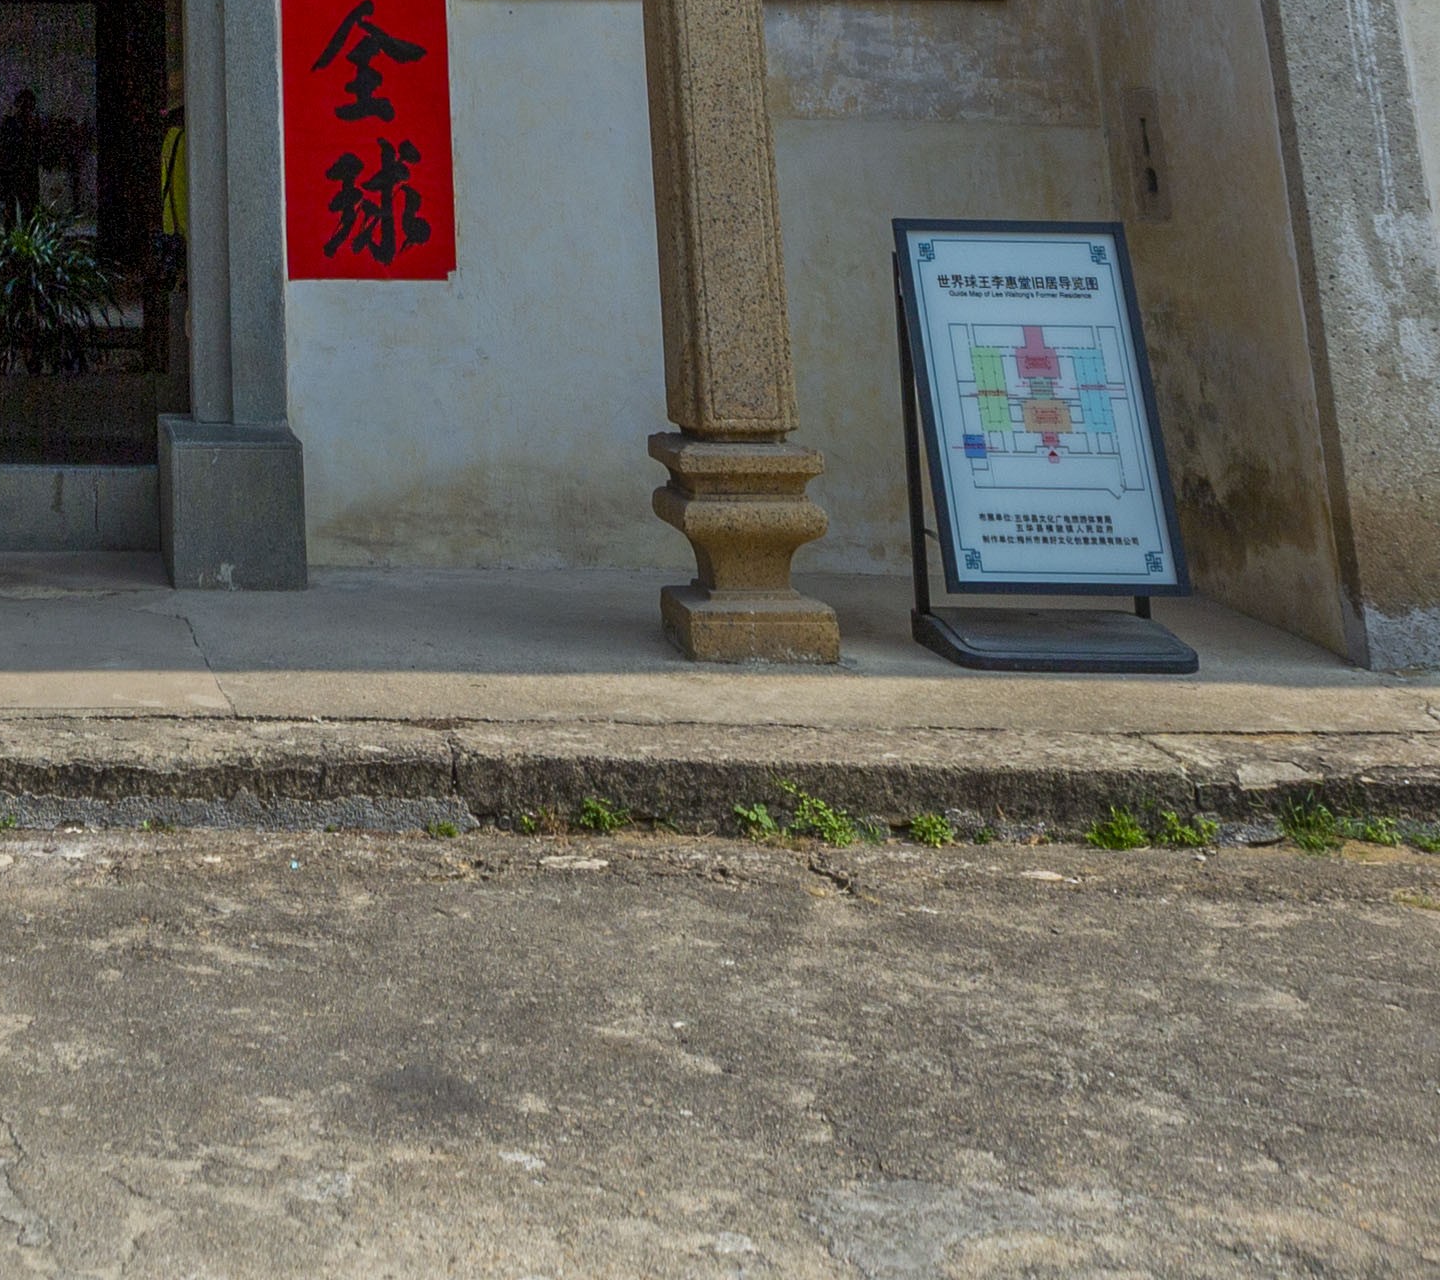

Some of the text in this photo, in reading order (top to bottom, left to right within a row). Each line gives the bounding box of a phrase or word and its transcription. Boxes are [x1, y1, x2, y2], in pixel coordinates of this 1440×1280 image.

[936, 274, 1099, 291] 世界球王李惠堂旧居导览图
